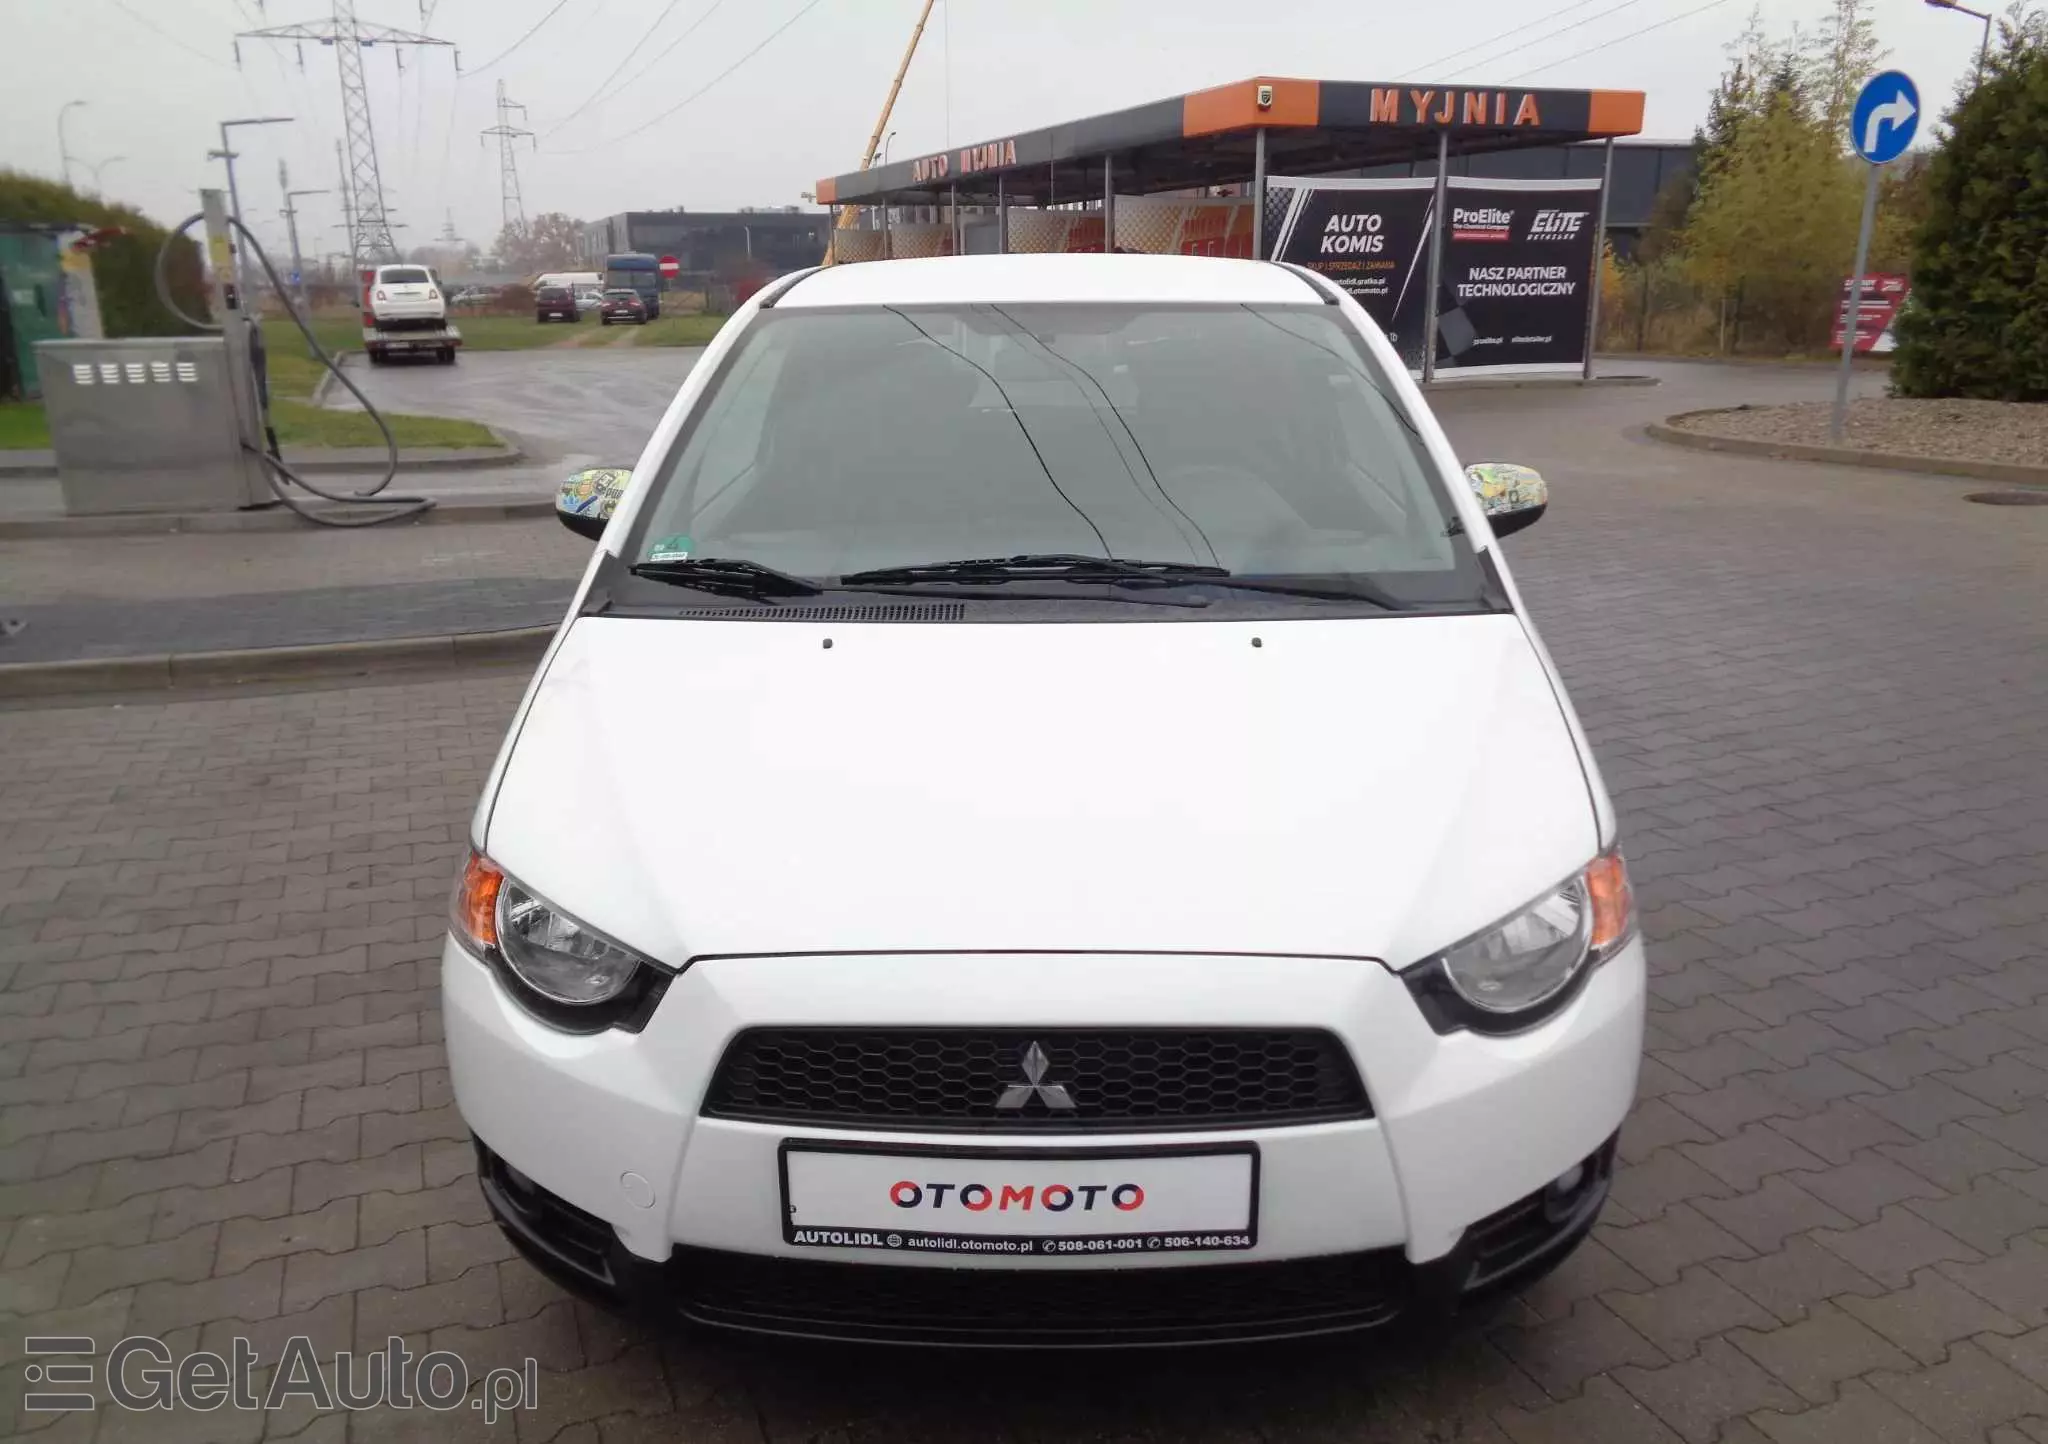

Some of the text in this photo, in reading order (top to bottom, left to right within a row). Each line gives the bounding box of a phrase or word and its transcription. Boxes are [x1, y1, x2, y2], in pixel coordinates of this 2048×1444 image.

[1369, 88, 1541, 126] MYJNIA
[913, 154, 949, 184] AUTO
[1324, 213, 1382, 233] AUTO
[1320, 234, 1385, 254] KOMIS
[1469, 266, 1567, 281] NASZ PARTNER
[1456, 281, 1577, 297] TECHNOLOGICZNY
[890, 1181, 1145, 1211] OTOMOTO
[794, 1230, 1250, 1252] AUTOLIDL autolidl.otomoto.pl 508-061-001 506-140-634
